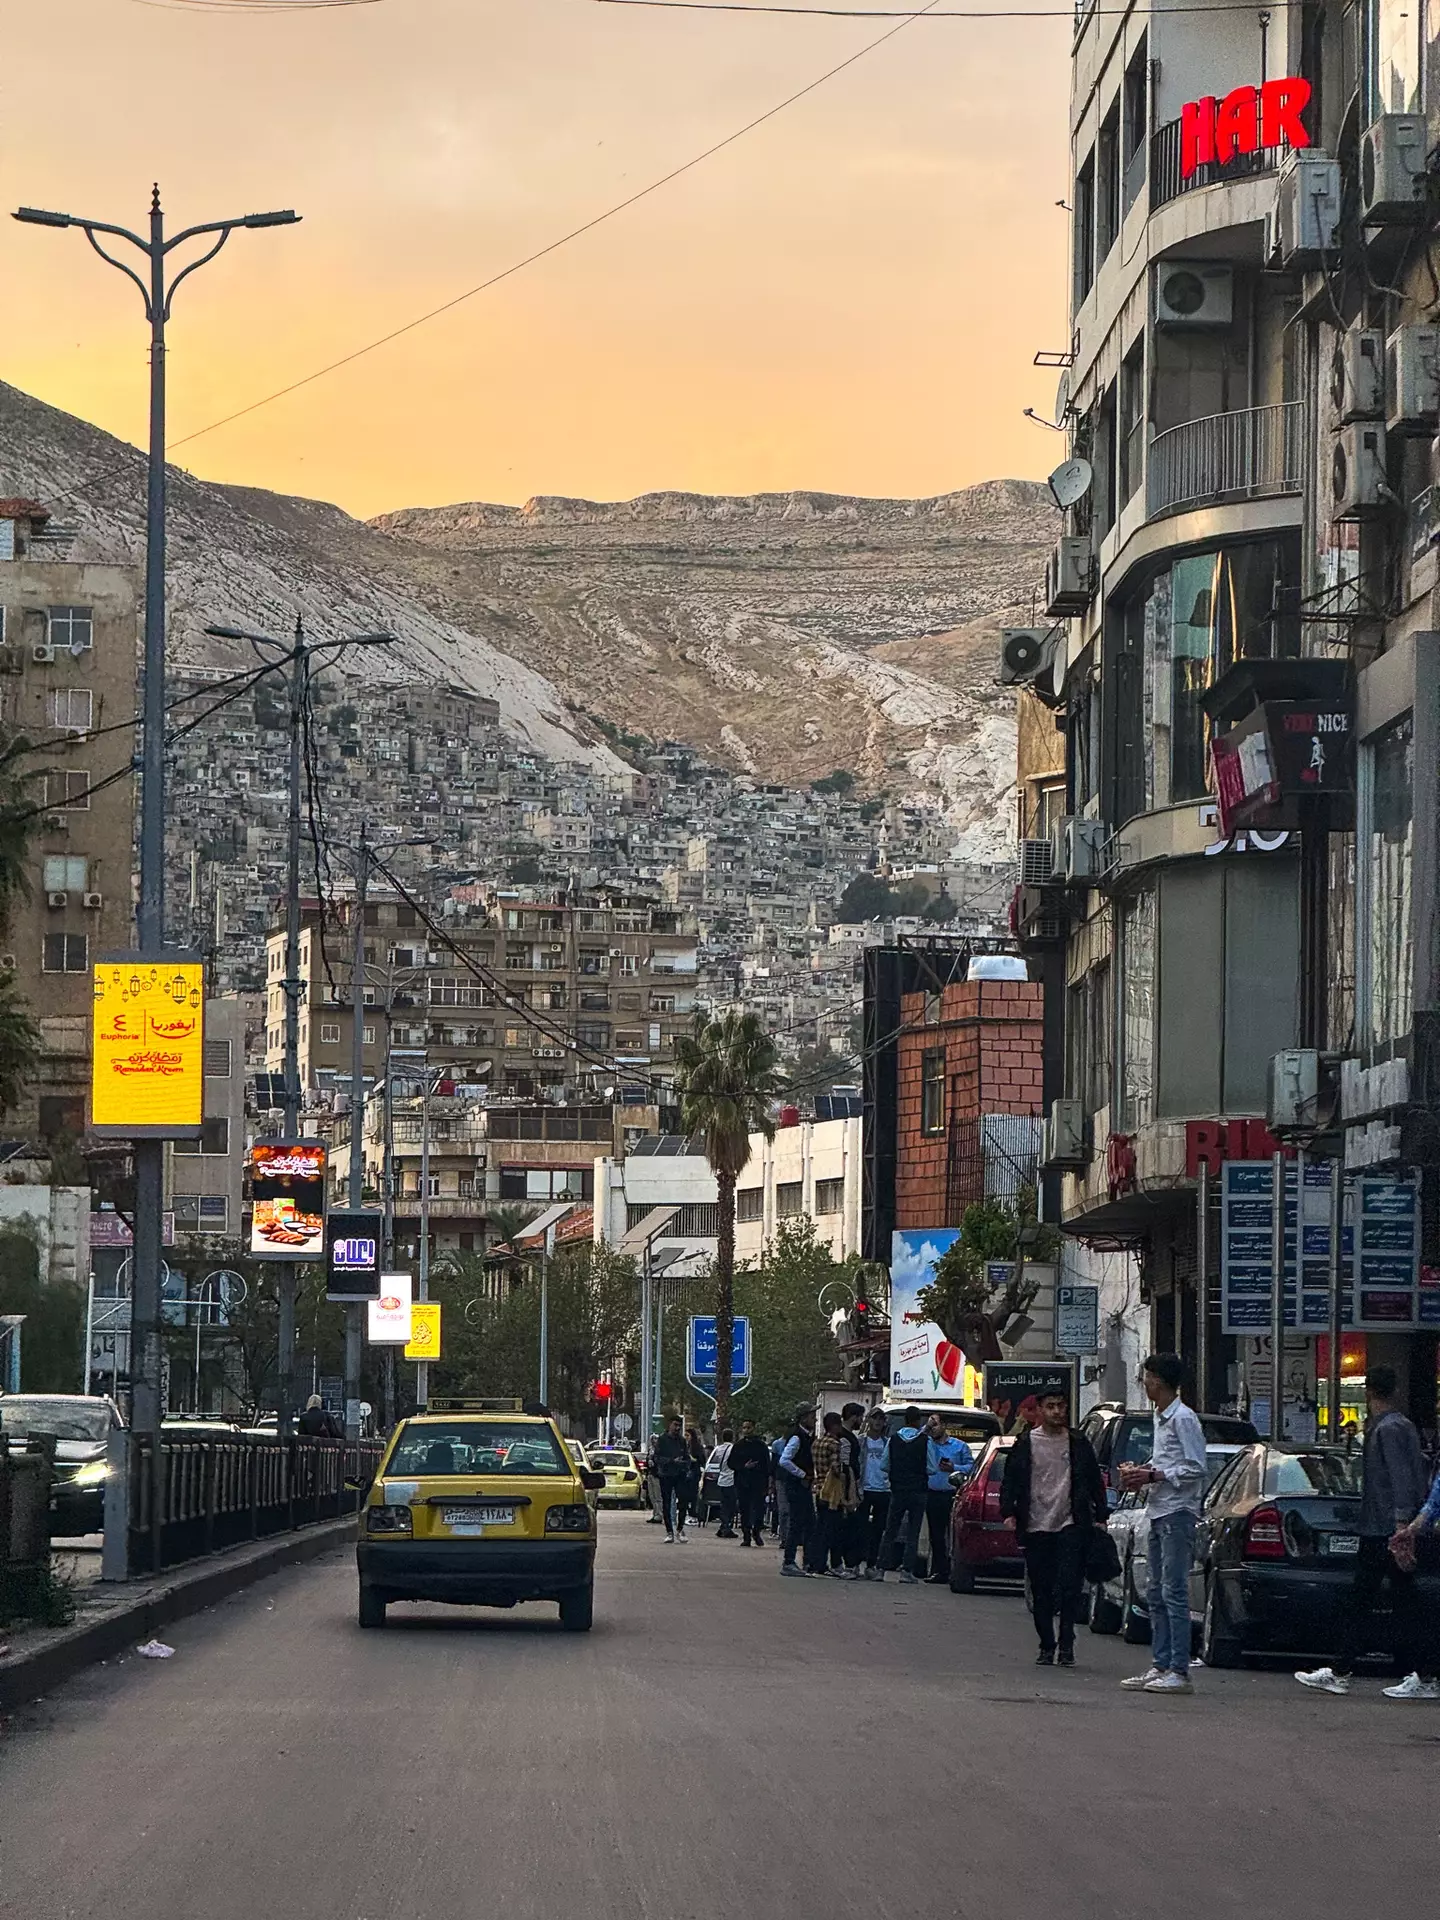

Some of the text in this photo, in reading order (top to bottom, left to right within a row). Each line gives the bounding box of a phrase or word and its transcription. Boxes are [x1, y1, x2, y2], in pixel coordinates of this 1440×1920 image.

[1181, 77, 1312, 180] HAR
[1318, 713, 1348, 732] NICE
[1060, 1290, 1072, 1304] P
